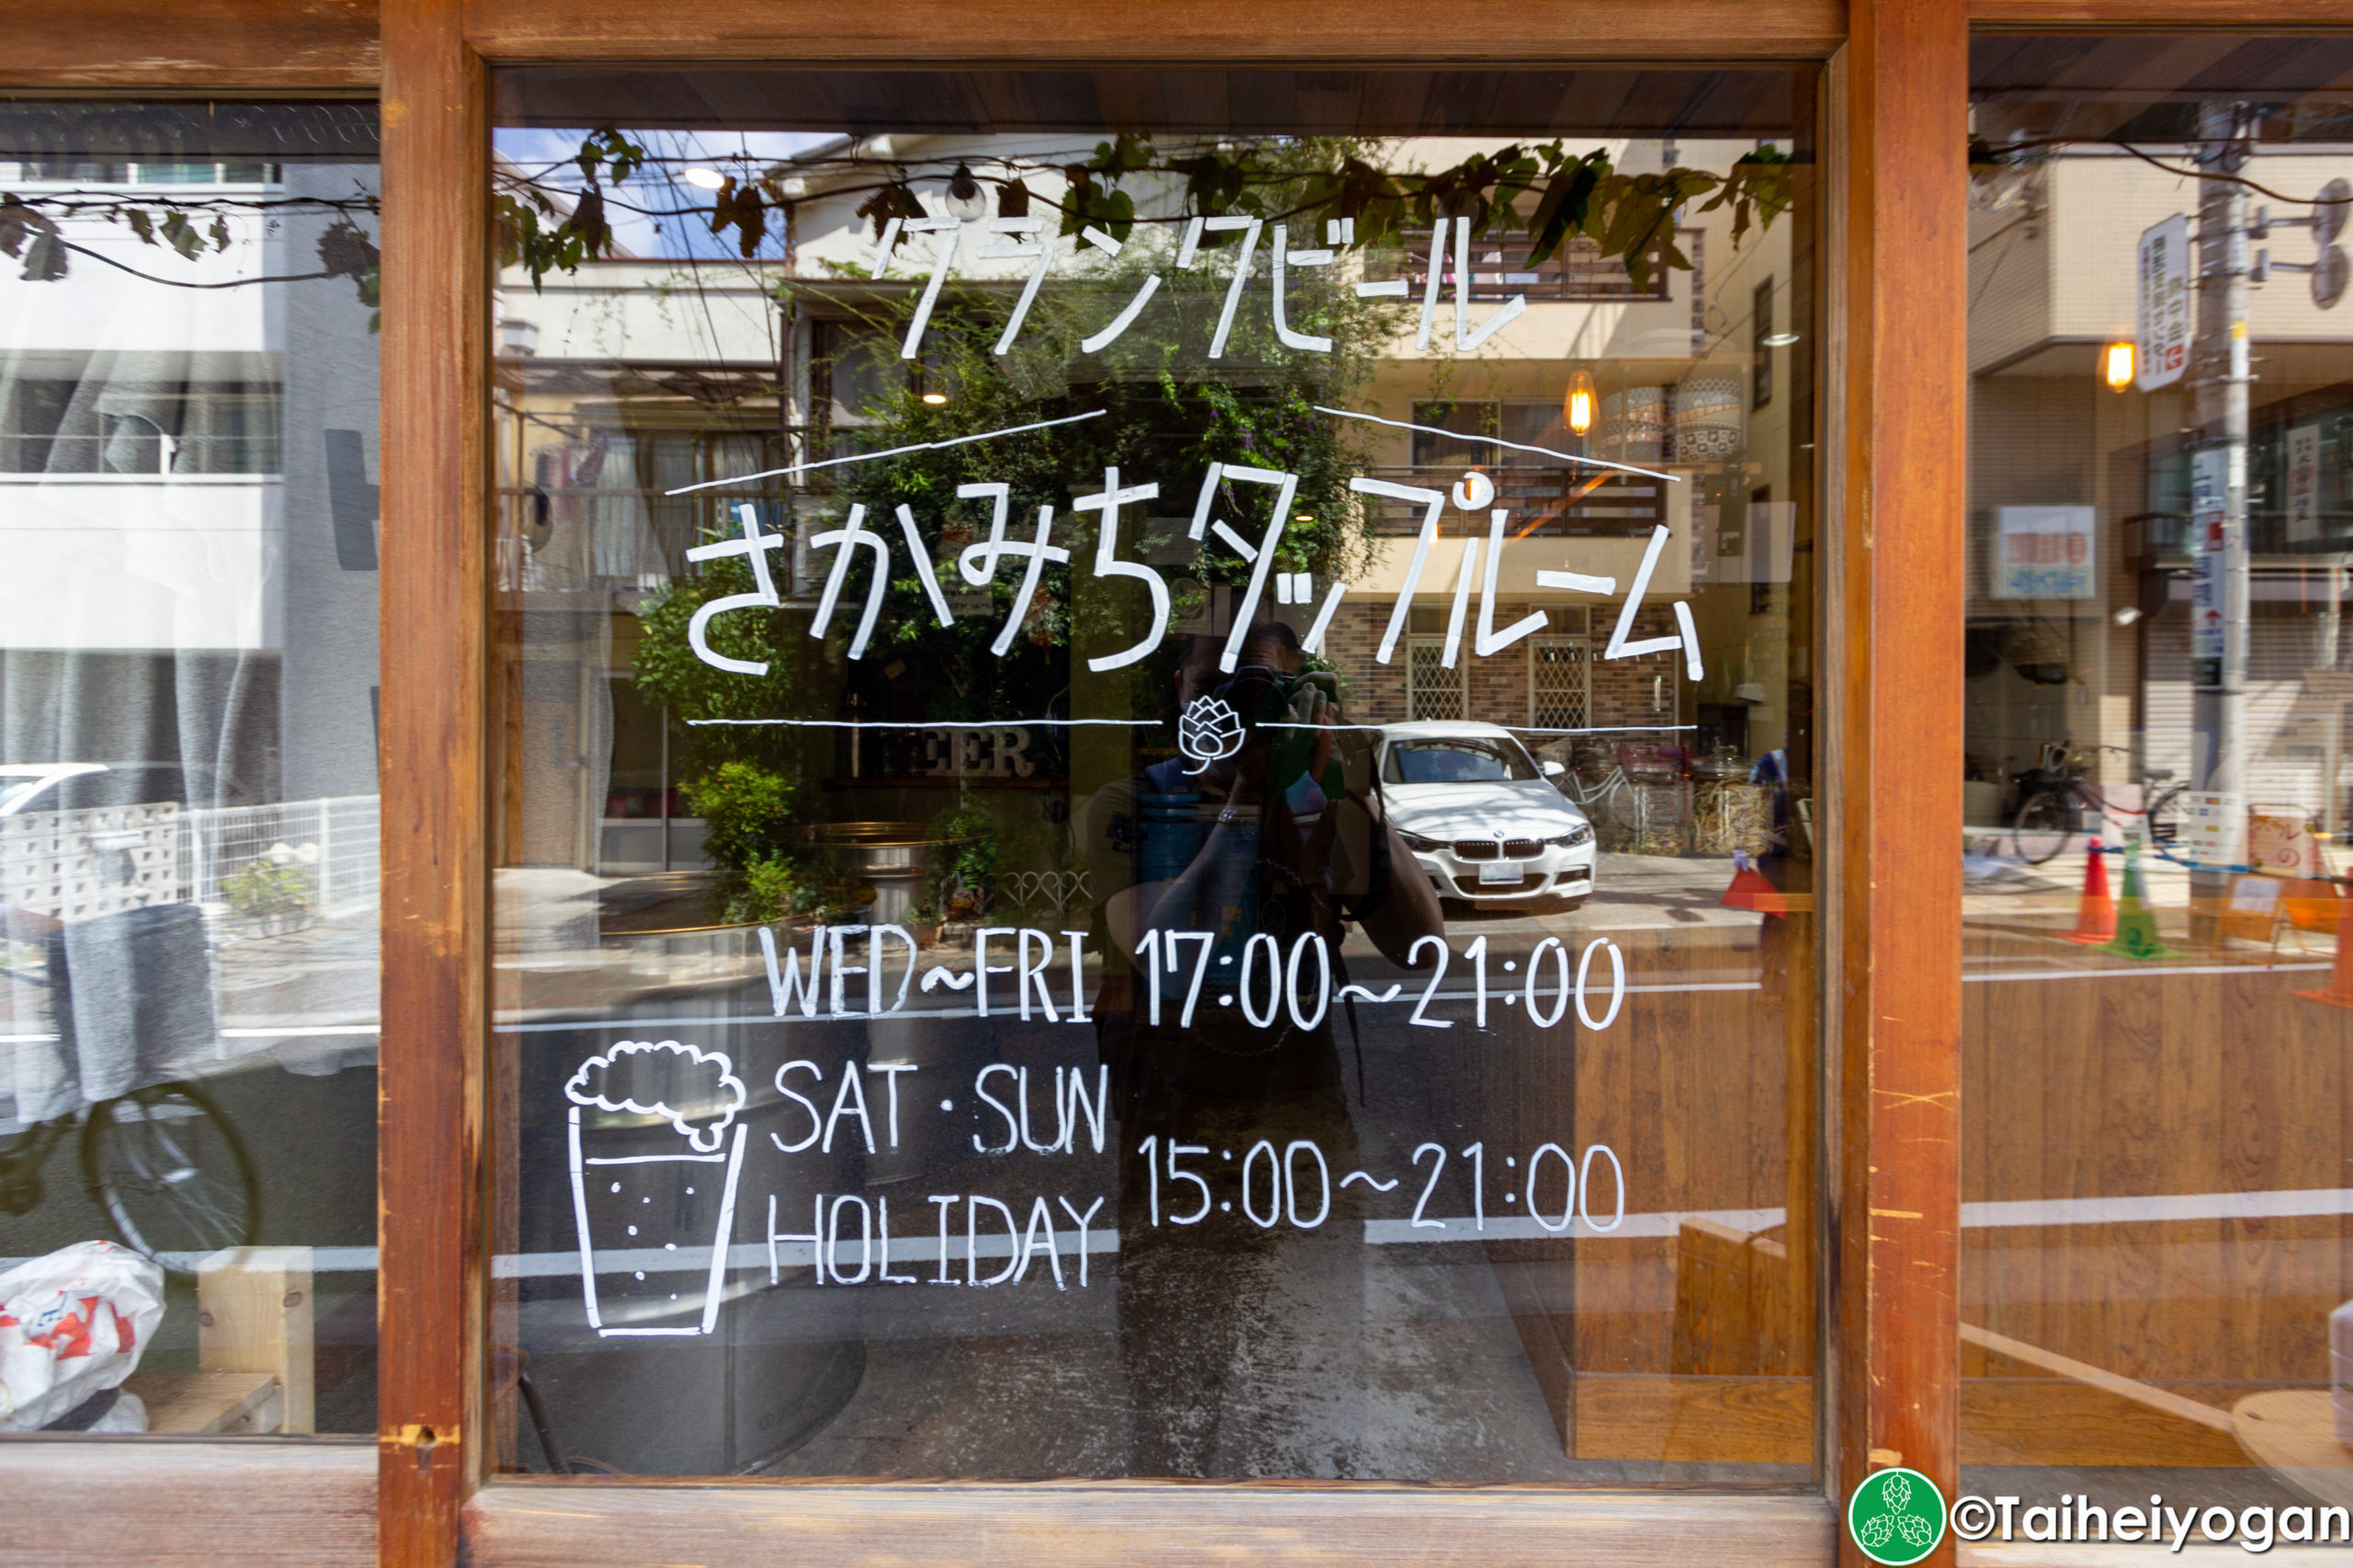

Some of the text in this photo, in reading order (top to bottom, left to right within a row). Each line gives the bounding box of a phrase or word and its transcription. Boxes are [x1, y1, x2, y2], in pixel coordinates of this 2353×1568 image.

[871, 215, 1527, 359] クランクビール
[686, 461, 1704, 682] さかみちタップルーム
[767, 1193, 1105, 1290] HOLIDAY
